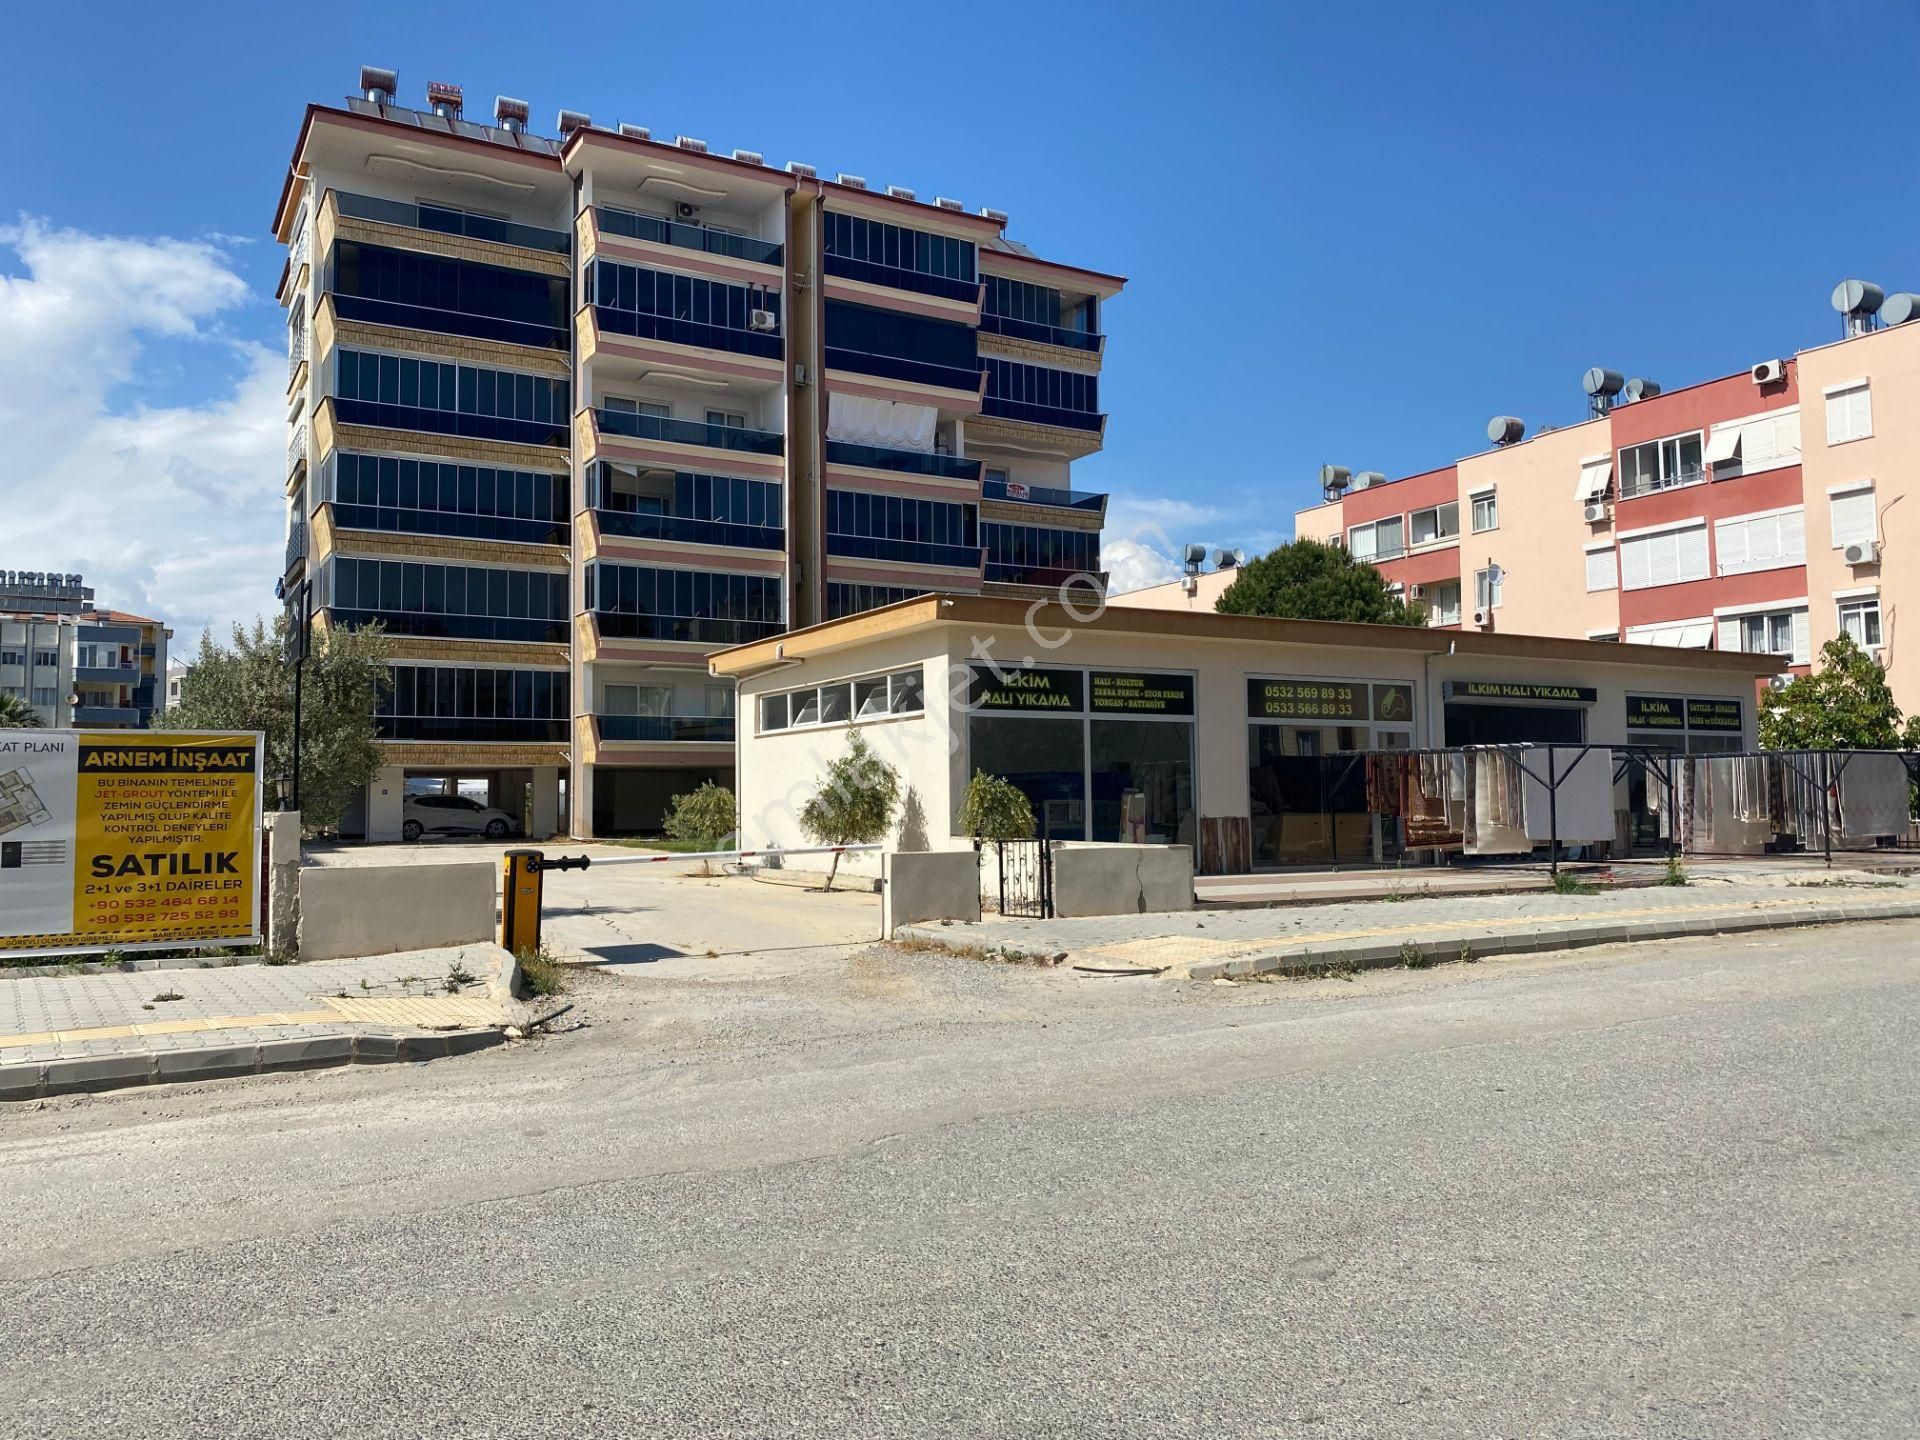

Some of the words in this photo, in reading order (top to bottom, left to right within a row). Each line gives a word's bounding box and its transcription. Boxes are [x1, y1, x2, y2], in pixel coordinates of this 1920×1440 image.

[1094, 678, 1111, 686] HALI
[1116, 678, 1144, 686] KOLTUK
[1265, 686, 1294, 698] 0532
[1297, 687, 1318, 698] 569
[1321, 688, 1335, 699] 89
[1338, 689, 1352, 699] 33
[1468, 682, 1500, 695] İLKİM
[1503, 685, 1530, 696] HALI
[1533, 687, 1580, 698] YIKAMA
[1016, 693, 1072, 706] YIKAMA
[1265, 702, 1294, 713] 0533
[1298, 703, 1318, 714] 566
[1322, 704, 1335, 714] 89
[1339, 704, 1352, 715] 33
[1641, 701, 1670, 712] İLKİM
[24, 742, 64, 753] PLANI
[84, 752, 166, 767] ARNEM
[172, 748, 250, 772] İNŞAAT
[98, 778, 115, 787] BU
[118, 777, 168, 787] BİNANIN
[171, 777, 236, 786] TEMELİNDE
[94, 790, 165, 798] JET-GROUT
[221, 788, 238, 797] İLE
[104, 800, 141, 810] ZEMİN
[145, 800, 228, 811] GÜÇLENDİRME
[100, 813, 154, 822] YAPILMIŞ
[193, 811, 232, 820] KALİTE
[105, 824, 162, 833] KONTROL
[164, 823, 228, 832] DENEYLERİ
[91, 851, 240, 878] SATILIK
[85, 884, 111, 894] 2+1
[137, 882, 162, 893] 3+1
[166, 878, 243, 892] DAİRELER
[88, 900, 120, 909] +90
[124, 899, 156, 909] 532
[160, 897, 194, 907] 464
[197, 896, 218, 905] 68
[222, 896, 240, 905] 14
[88, 914, 119, 924] +90
[124, 913, 156, 923] 532
[160, 911, 190, 921] 725
[194, 910, 214, 920] 52
[219, 909, 240, 919] 99
